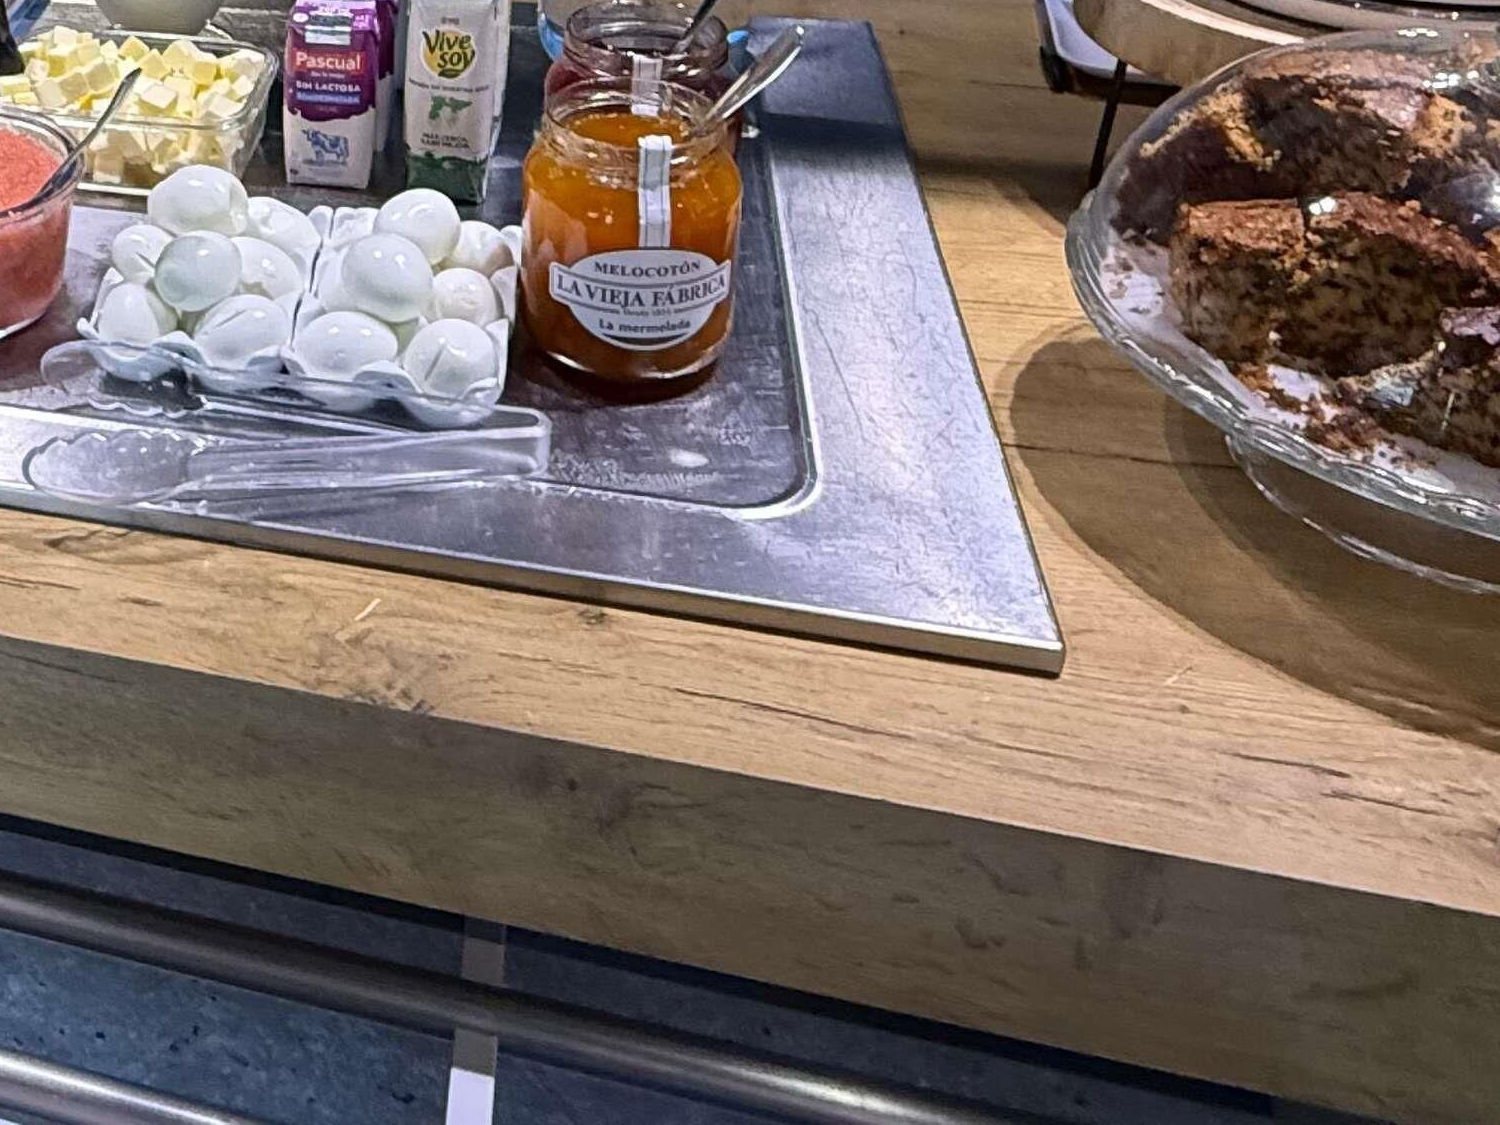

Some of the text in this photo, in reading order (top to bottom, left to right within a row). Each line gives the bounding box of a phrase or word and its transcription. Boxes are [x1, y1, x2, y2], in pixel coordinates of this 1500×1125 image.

[421, 29, 473, 55] Vive
[296, 51, 362, 71] Pascual
[436, 48, 476, 70] soy
[593, 260, 700, 278] MELOCOTÓN
[557, 272, 727, 308] LA VIEJA FÁBRICA
[599, 318, 692, 333] La mermelada
